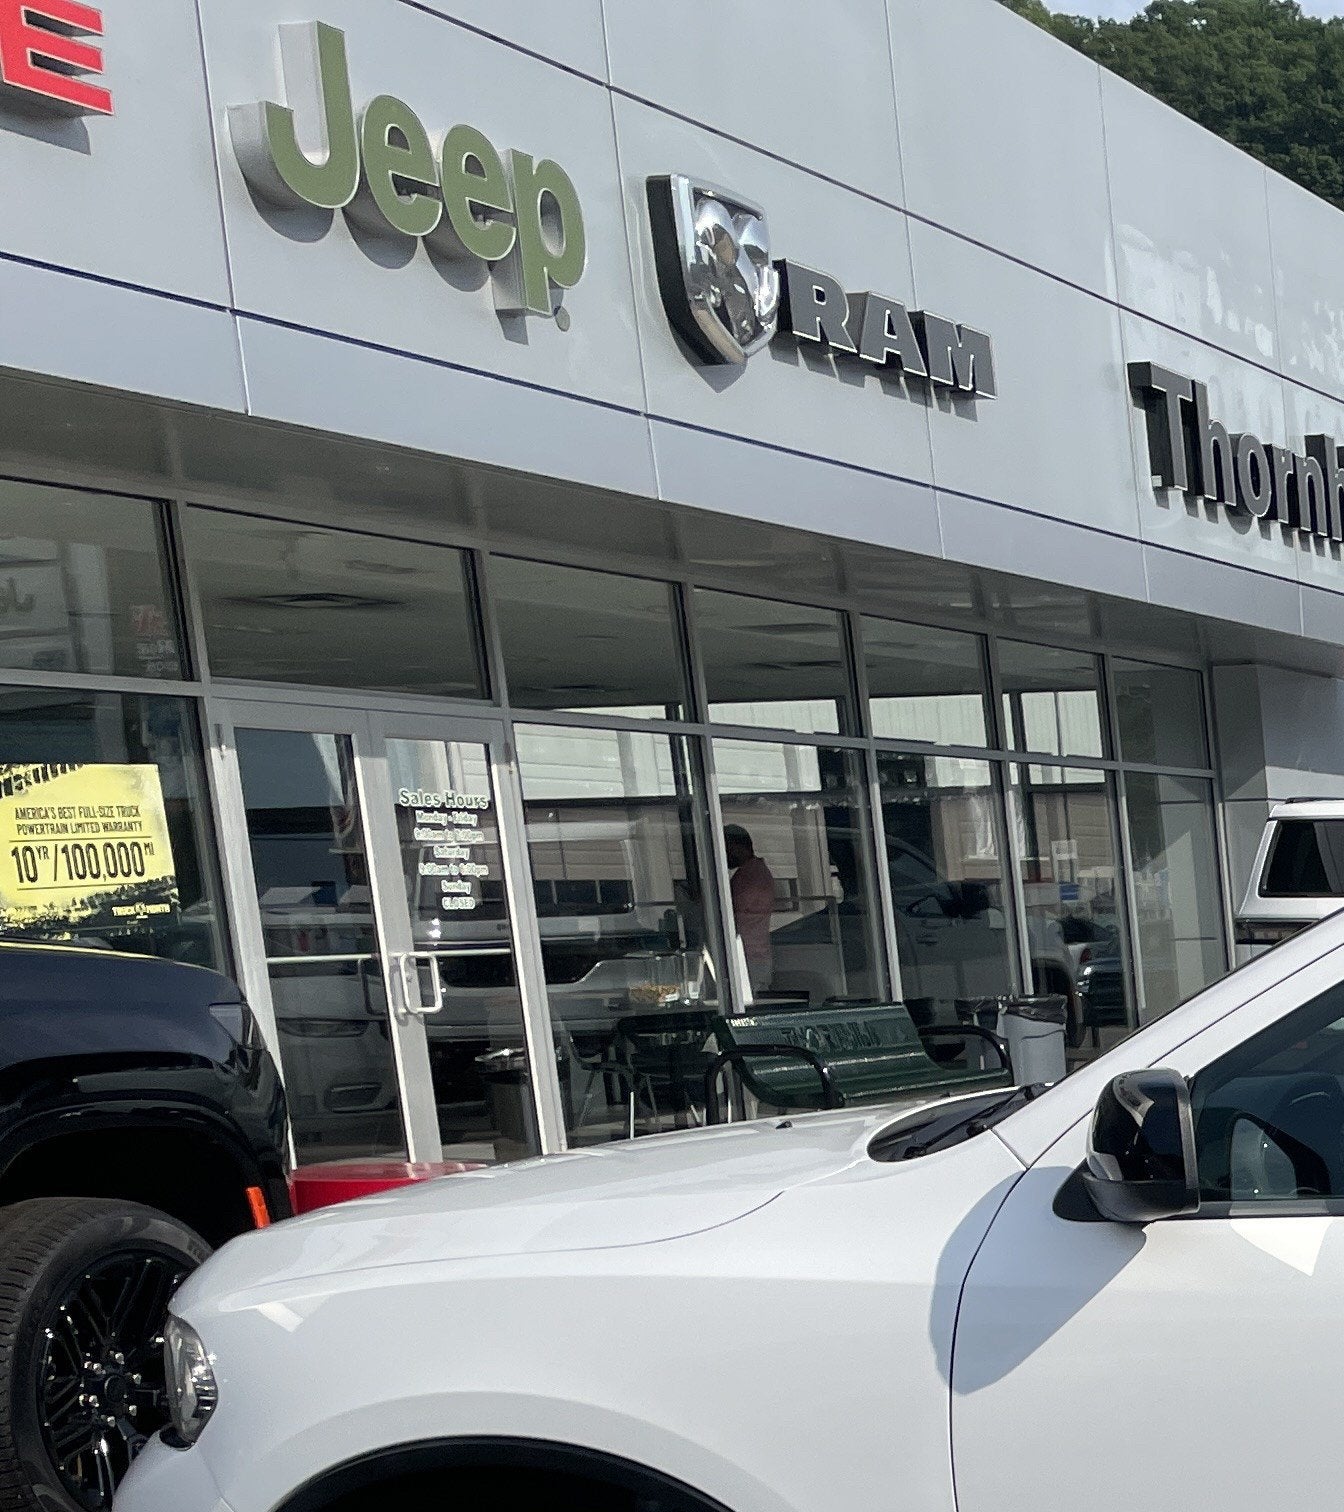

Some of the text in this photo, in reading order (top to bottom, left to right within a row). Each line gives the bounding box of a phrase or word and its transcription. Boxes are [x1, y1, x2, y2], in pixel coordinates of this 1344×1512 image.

[262, 20, 588, 316] Jeep
[775, 258, 998, 400] RAM
[399, 787, 489, 810] Sales Hours
[15, 805, 141, 820] AMERICA'S BEST FULL-SIZE TRUCK
[16, 820, 143, 836] POWERTRAIN LIMITED WARRANTY
